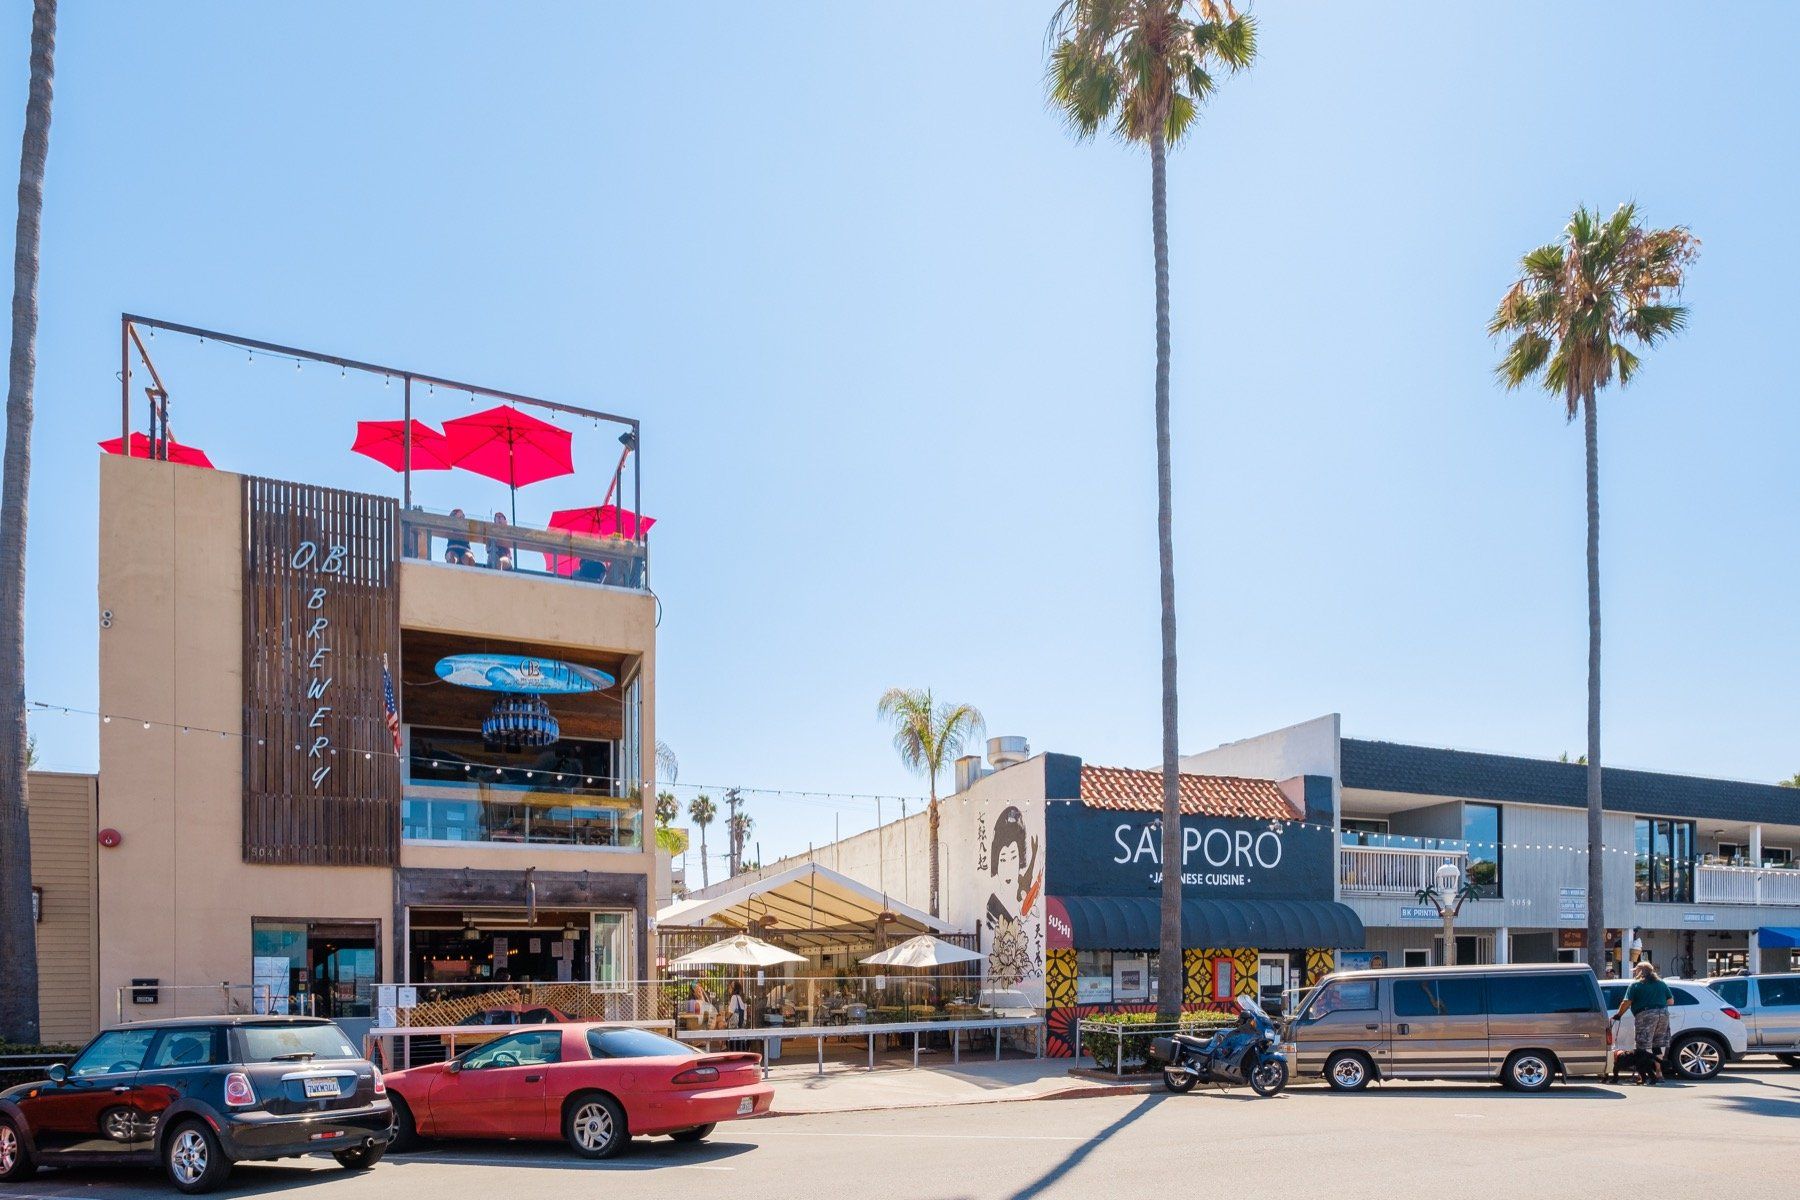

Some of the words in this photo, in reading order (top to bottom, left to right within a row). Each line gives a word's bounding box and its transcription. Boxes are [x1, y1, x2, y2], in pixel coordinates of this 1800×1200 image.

[292, 541, 347, 576] O.B.
[307, 588, 332, 789] BREWERY
[1114, 824, 1282, 869] SAPORO
[1154, 872, 1203, 884] JANESE
[1206, 873, 1245, 886] CUISINE
[1048, 914, 1070, 938] SUSHI
[1413, 909, 1438, 917] PRINTIN
